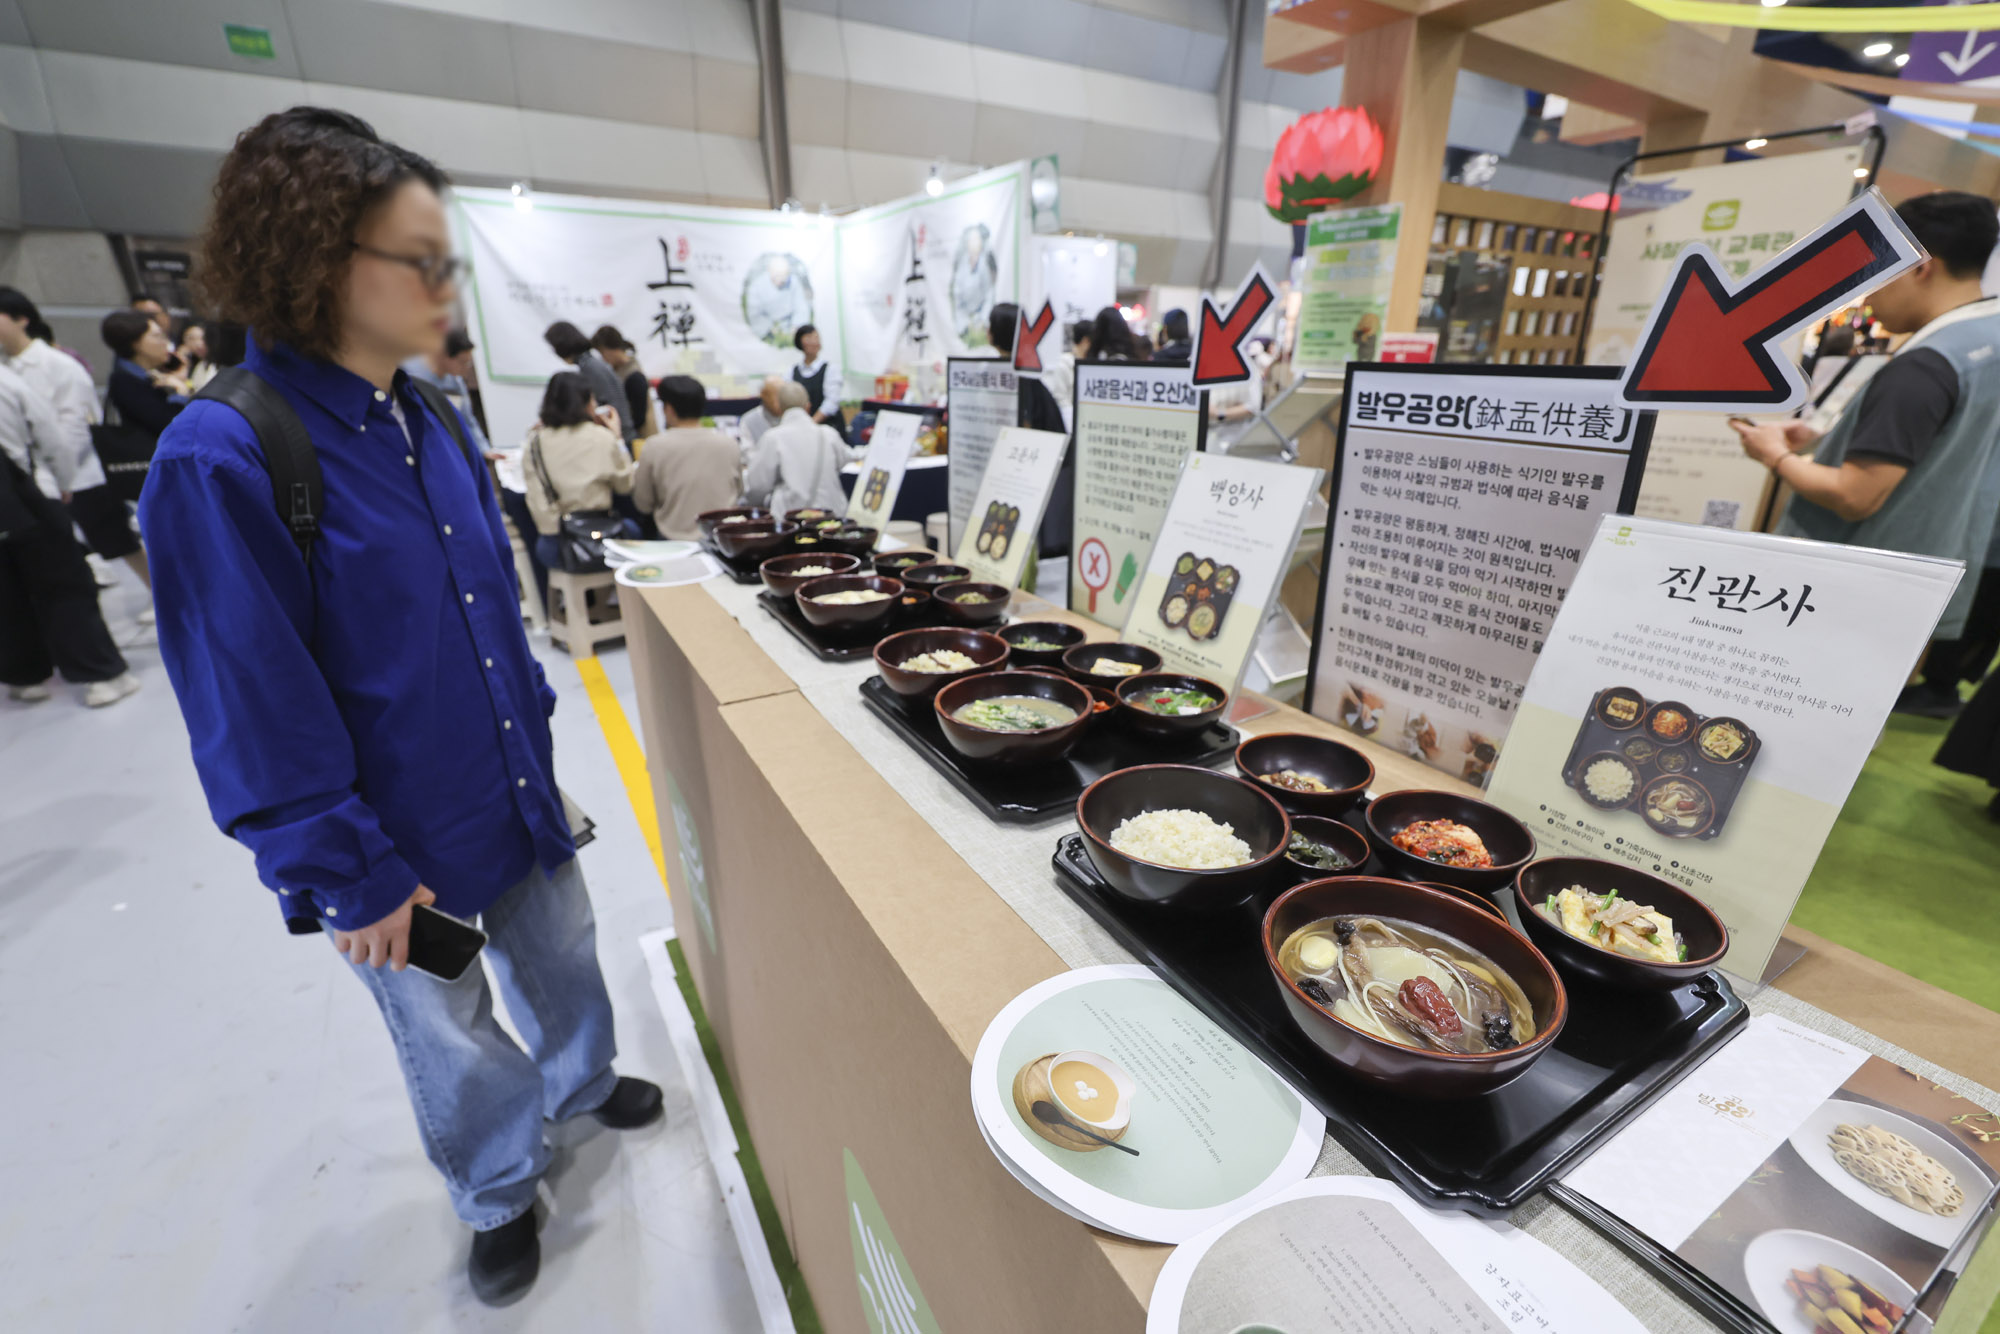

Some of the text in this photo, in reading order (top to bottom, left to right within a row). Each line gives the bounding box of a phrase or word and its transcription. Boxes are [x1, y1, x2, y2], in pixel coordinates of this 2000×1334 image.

[1084, 378, 1148, 402] 사찰음식과
[1362, 465, 1589, 511] 이용하여 사찰의 규범과 법식에 따라 음식을
[1365, 448, 1604, 491] 발우공양은 스님들이 사용하는 식기인 발우를
[1210, 479, 1263, 511] 백양사
[1360, 482, 1462, 511] 먹는 식사 의례입니다.
[1351, 524, 1556, 579] 따라 조용히 이루어지는 것이 원칙입니다.
[1354, 508, 1402, 528] 발우공양은
[1455, 526, 1490, 546] 정해진
[1540, 543, 1581, 563] 법식에
[1350, 540, 1378, 556] 자신의
[1381, 547, 1410, 564] 발우에
[1413, 553, 1444, 573] 음식을
[1447, 561, 1470, 578] 담아
[1474, 567, 1498, 585] 먹기
[1501, 574, 1553, 599] 시작하면
[1384, 581, 1415, 600] 깨끗이
[1442, 596, 1464, 614] 모든
[1467, 603, 1491, 622] 음식
[1494, 610, 1544, 636] 잔여물도
[1391, 566, 1421, 585] 음식을
[1425, 574, 1445, 590] 모두
[1448, 579, 1483, 600] 먹어야
[1517, 597, 1557, 620] 마지막
[1657, 565, 1816, 628] 진관사
[1374, 612, 1383, 625] 수
[1386, 615, 1429, 639] 있습니다.
[1398, 601, 1429, 621] 그리고
[1431, 611, 1477, 636] 깨끗하게
[1479, 625, 1528, 651] 마무리된
[1689, 615, 1743, 636] Jinkwansa
[1429, 655, 1460, 676] 미덕이
[1464, 666, 1487, 686] 있는
[1647, 640, 1679, 656] 진관사의
[1682, 648, 1726, 669] 사찰음식은
[1730, 660, 1757, 676] 전통을
[1759, 668, 1802, 689] 중시한다.
[1728, 645, 1756, 660] 하나로
[1759, 652, 1790, 668] 꼽히는
[1436, 690, 1482, 719] 있습니다.
[1476, 688, 1510, 712] 오늘날
[1705, 685, 1751, 706] 사찰음식을
[1754, 698, 1795, 719] 제공한다.
[1723, 675, 1760, 693] 생각으로
[1830, 703, 1853, 717] 이어
[1663, 868, 1694, 887] 두부조림
[1681, 864, 1713, 884] 산초간장
[1484, 1262, 1558, 1334] 감자표고버
